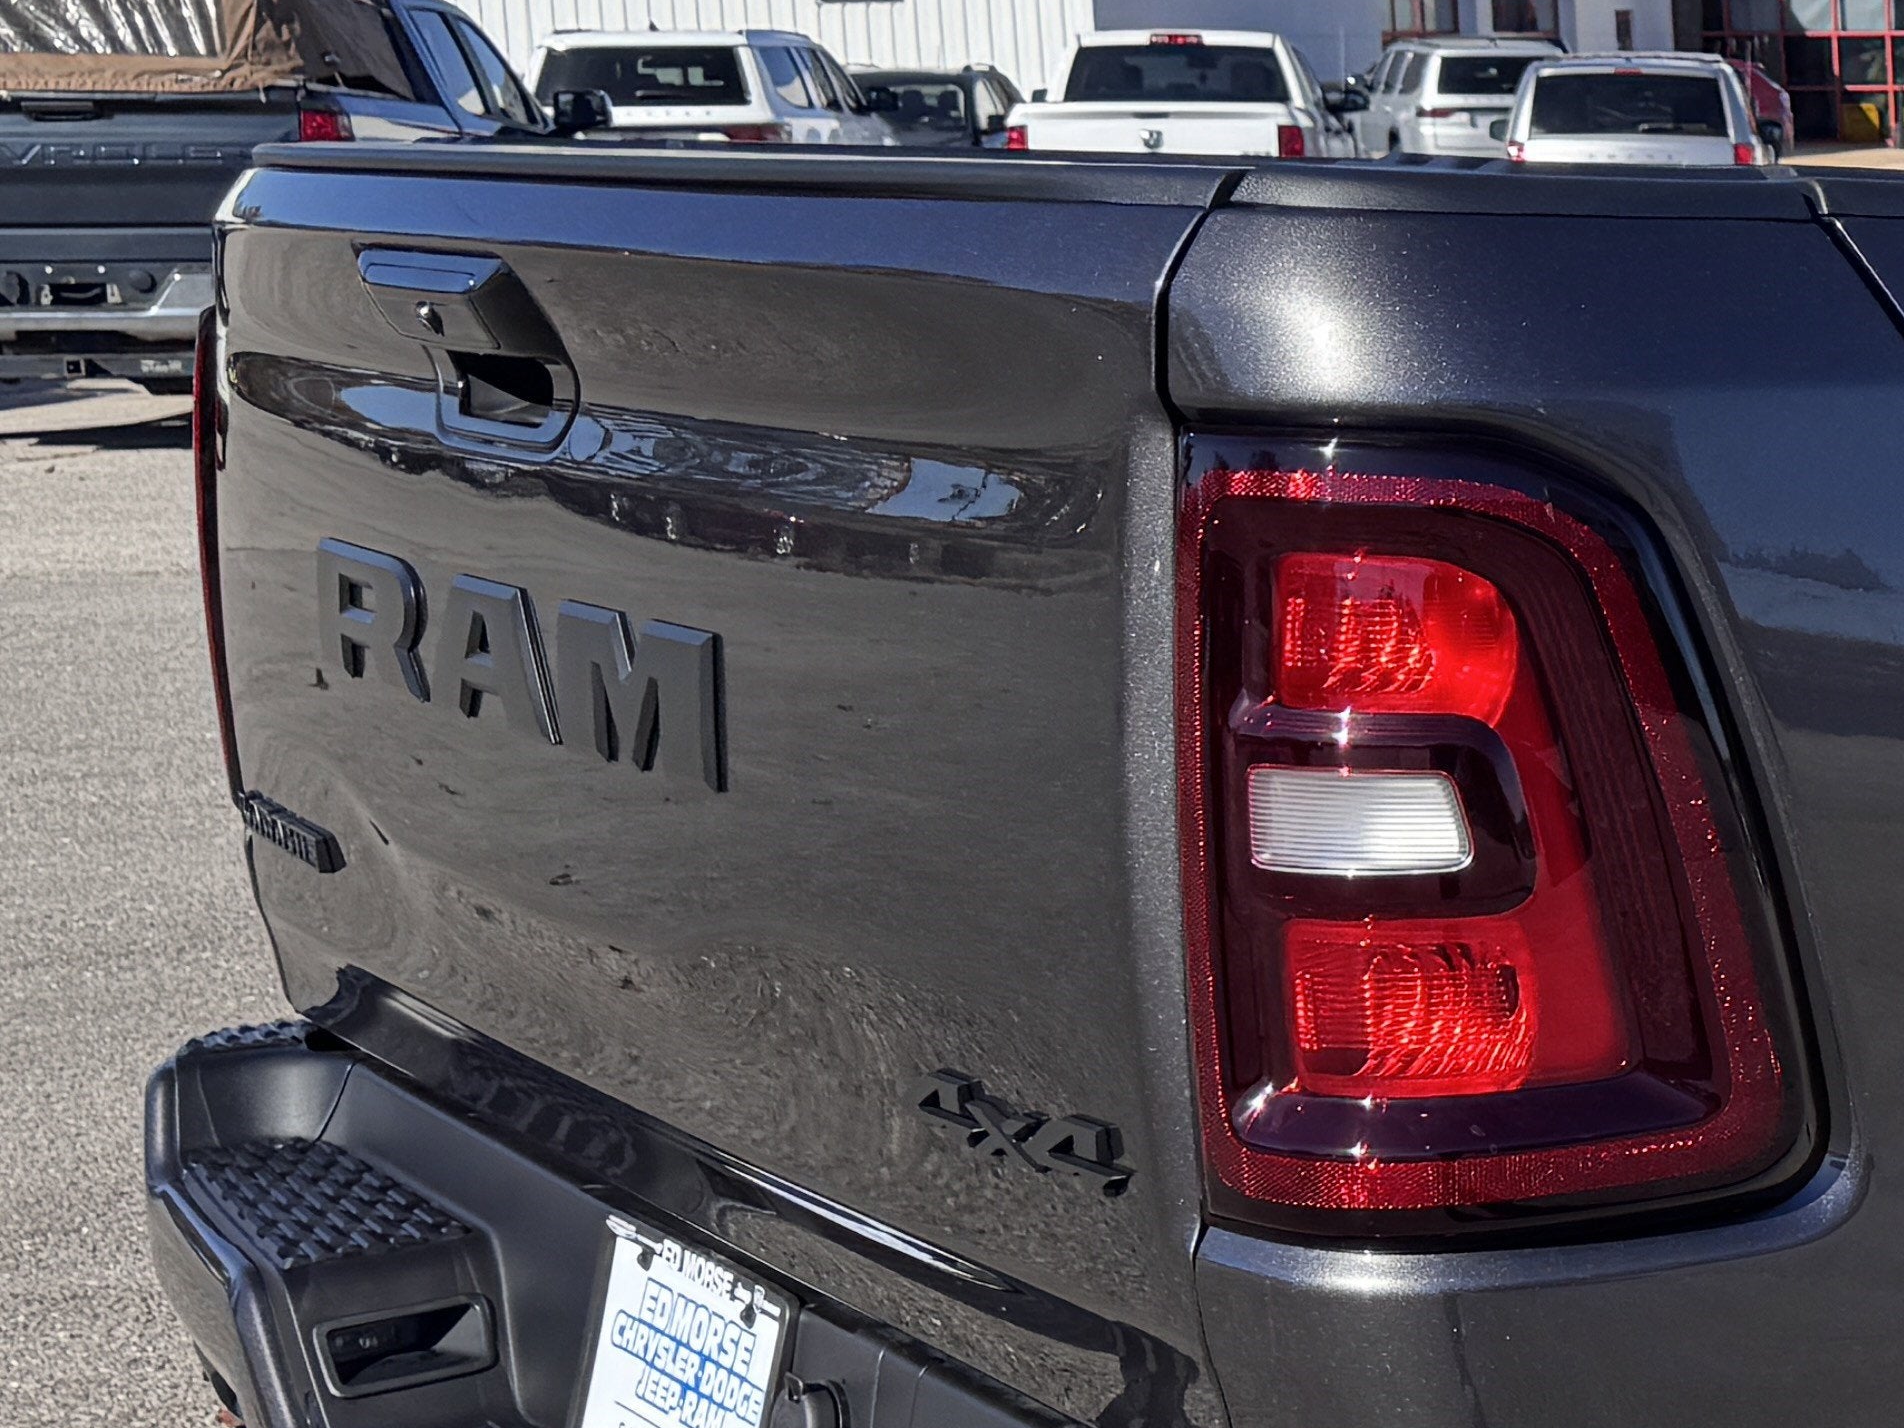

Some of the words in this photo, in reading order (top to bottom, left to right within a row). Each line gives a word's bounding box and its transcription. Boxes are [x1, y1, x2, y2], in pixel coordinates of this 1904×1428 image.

[316, 536, 730, 794] RAM
[661, 1238, 682, 1272] ED
[682, 1249, 735, 1303] MORSE
[639, 1276, 674, 1333] ED
[671, 1292, 758, 1377] MORSE
